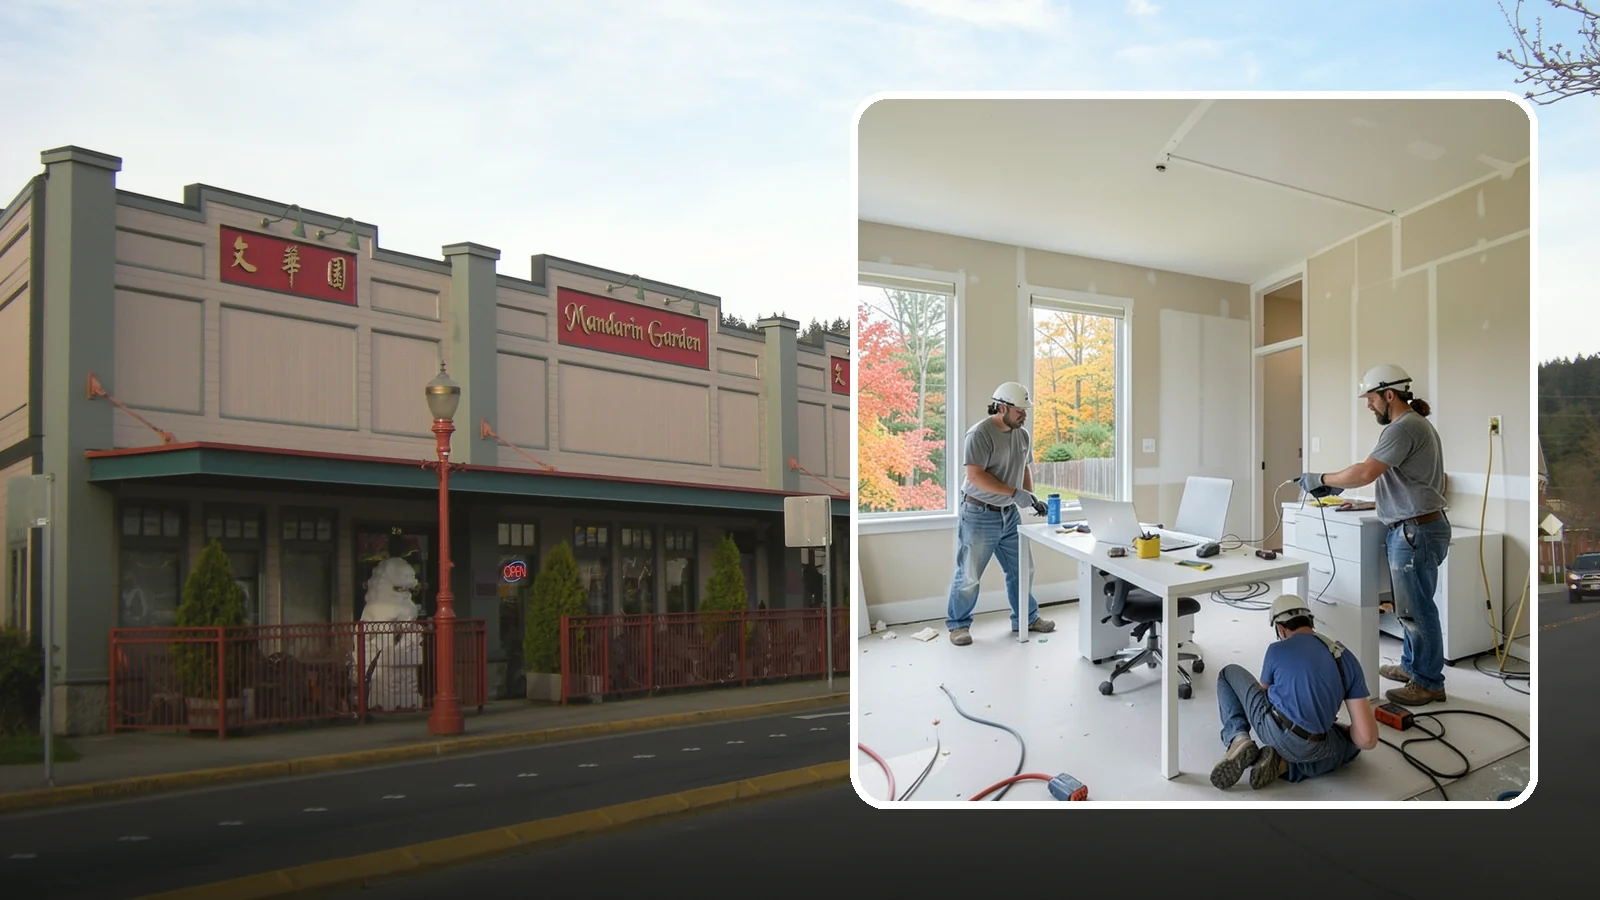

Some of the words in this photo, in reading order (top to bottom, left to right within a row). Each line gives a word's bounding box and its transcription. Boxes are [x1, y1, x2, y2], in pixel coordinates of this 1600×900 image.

[231, 235, 346, 291] 文華園
[565, 302, 643, 340] Mandarin
[648, 320, 701, 352] Garden
[503, 565, 527, 578] OPEN
